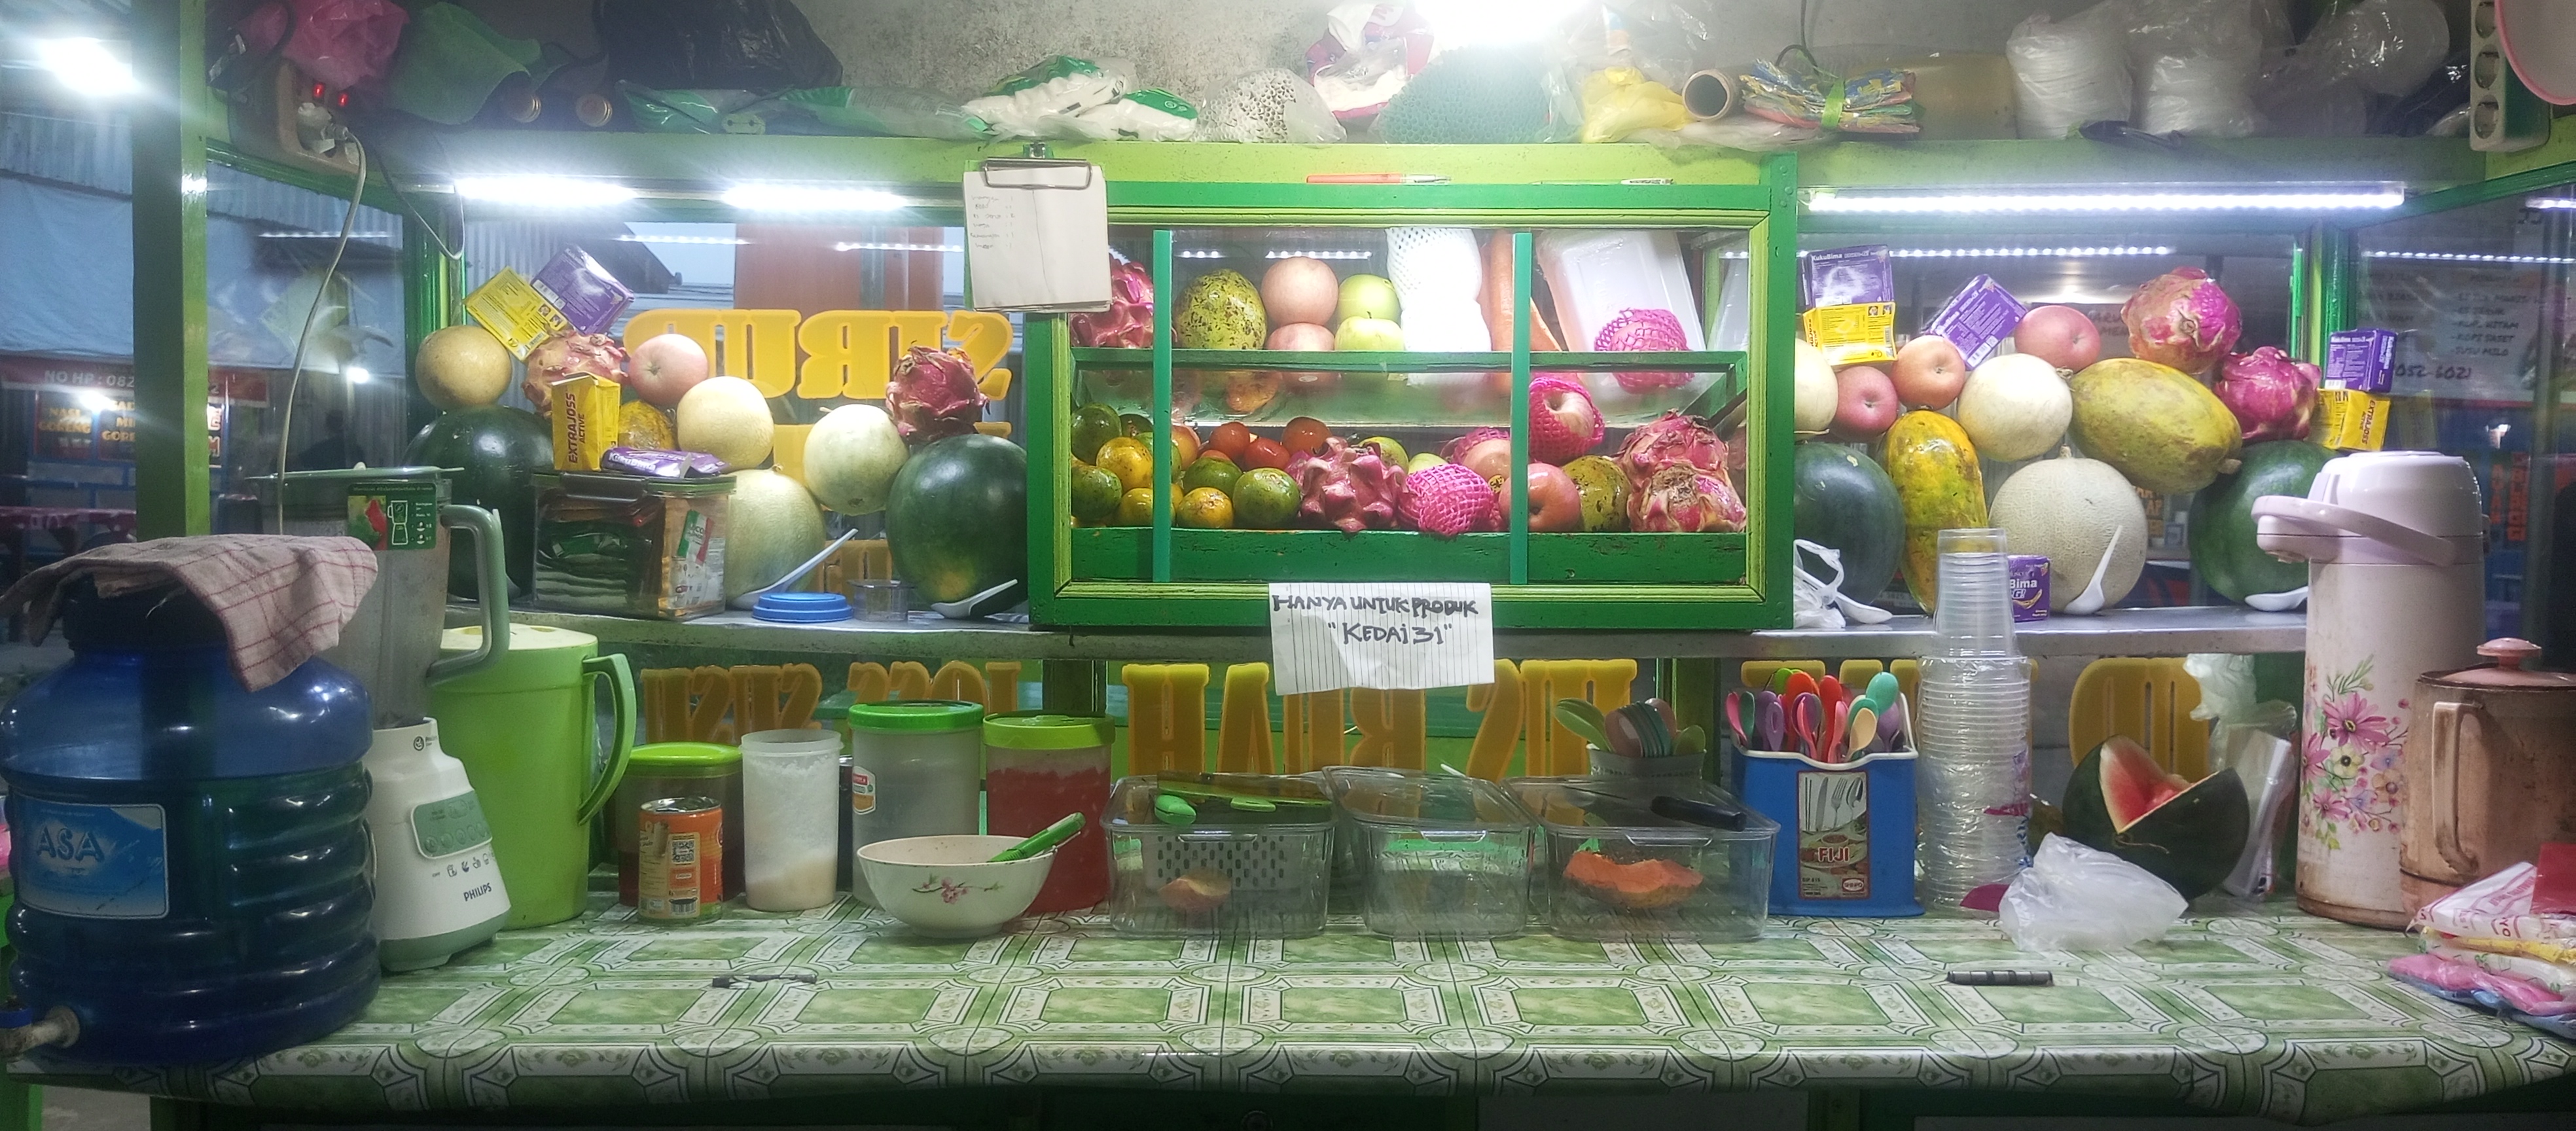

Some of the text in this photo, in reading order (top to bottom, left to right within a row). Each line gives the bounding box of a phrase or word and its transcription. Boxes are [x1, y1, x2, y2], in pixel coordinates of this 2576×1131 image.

[565, 392, 579, 464] EXTRAJOSS
[2361, 399, 2376, 445] EXTRAJOSS
[1272, 594, 1479, 619] HANYA UNTUK PRODUK
[36, 825, 105, 863] ASA
[1818, 847, 1850, 863] FIJI
[463, 882, 492, 902] PHILIPS
